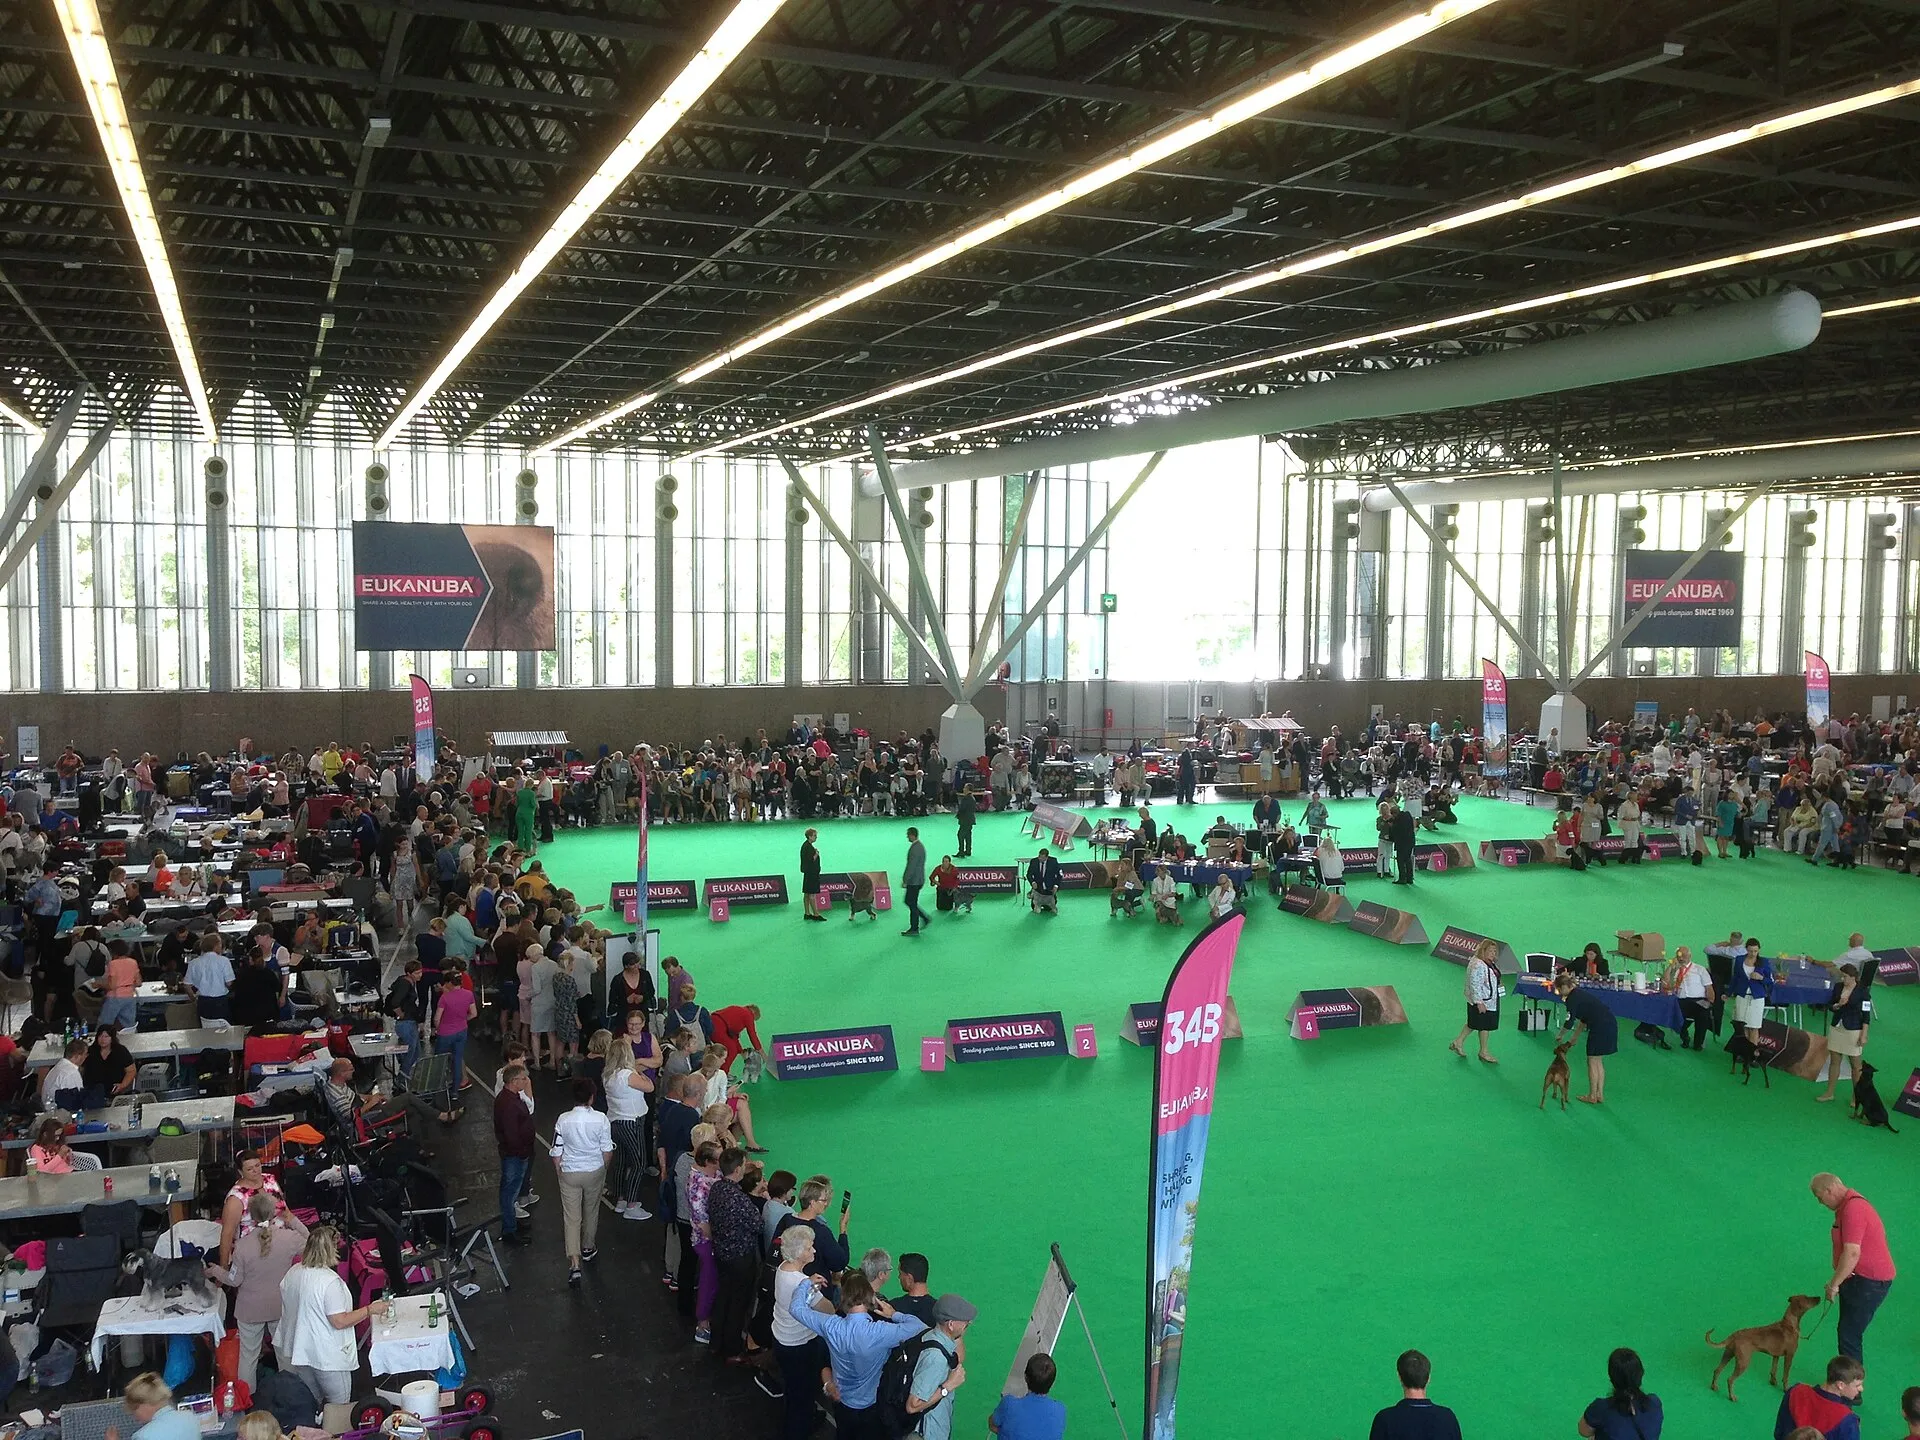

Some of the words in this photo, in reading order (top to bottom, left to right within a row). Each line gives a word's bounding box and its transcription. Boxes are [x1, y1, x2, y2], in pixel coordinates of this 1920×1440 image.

[361, 578, 474, 593] EUKANUBA
[1694, 608, 1716, 616] SINCE
[1718, 608, 1735, 616] 1969
[618, 887, 682, 897] EUKNUBA
[712, 882, 773, 893] EUKANUBA
[820, 896, 826, 905] 3
[880, 896, 886, 904] 4
[631, 909, 636, 917] 1
[717, 908, 724, 916] 2
[958, 1023, 1045, 1041] EUKANUBA
[1165, 1003, 1222, 1055] 34B
[1305, 1021, 1313, 1032] 4
[783, 1037, 874, 1057] EUKANUBA
[994, 1043, 1018, 1052] champion
[1018, 1041, 1039, 1049] SINCE
[1039, 1040, 1056, 1048] 1969
[1082, 1038, 1090, 1050] 2
[929, 1052, 936, 1063] 1
[786, 1063, 808, 1072] Feeding
[808, 1062, 821, 1071] your
[820, 1060, 846, 1069] champion
[846, 1056, 867, 1065] SINCE
[868, 1055, 885, 1063] 1969
